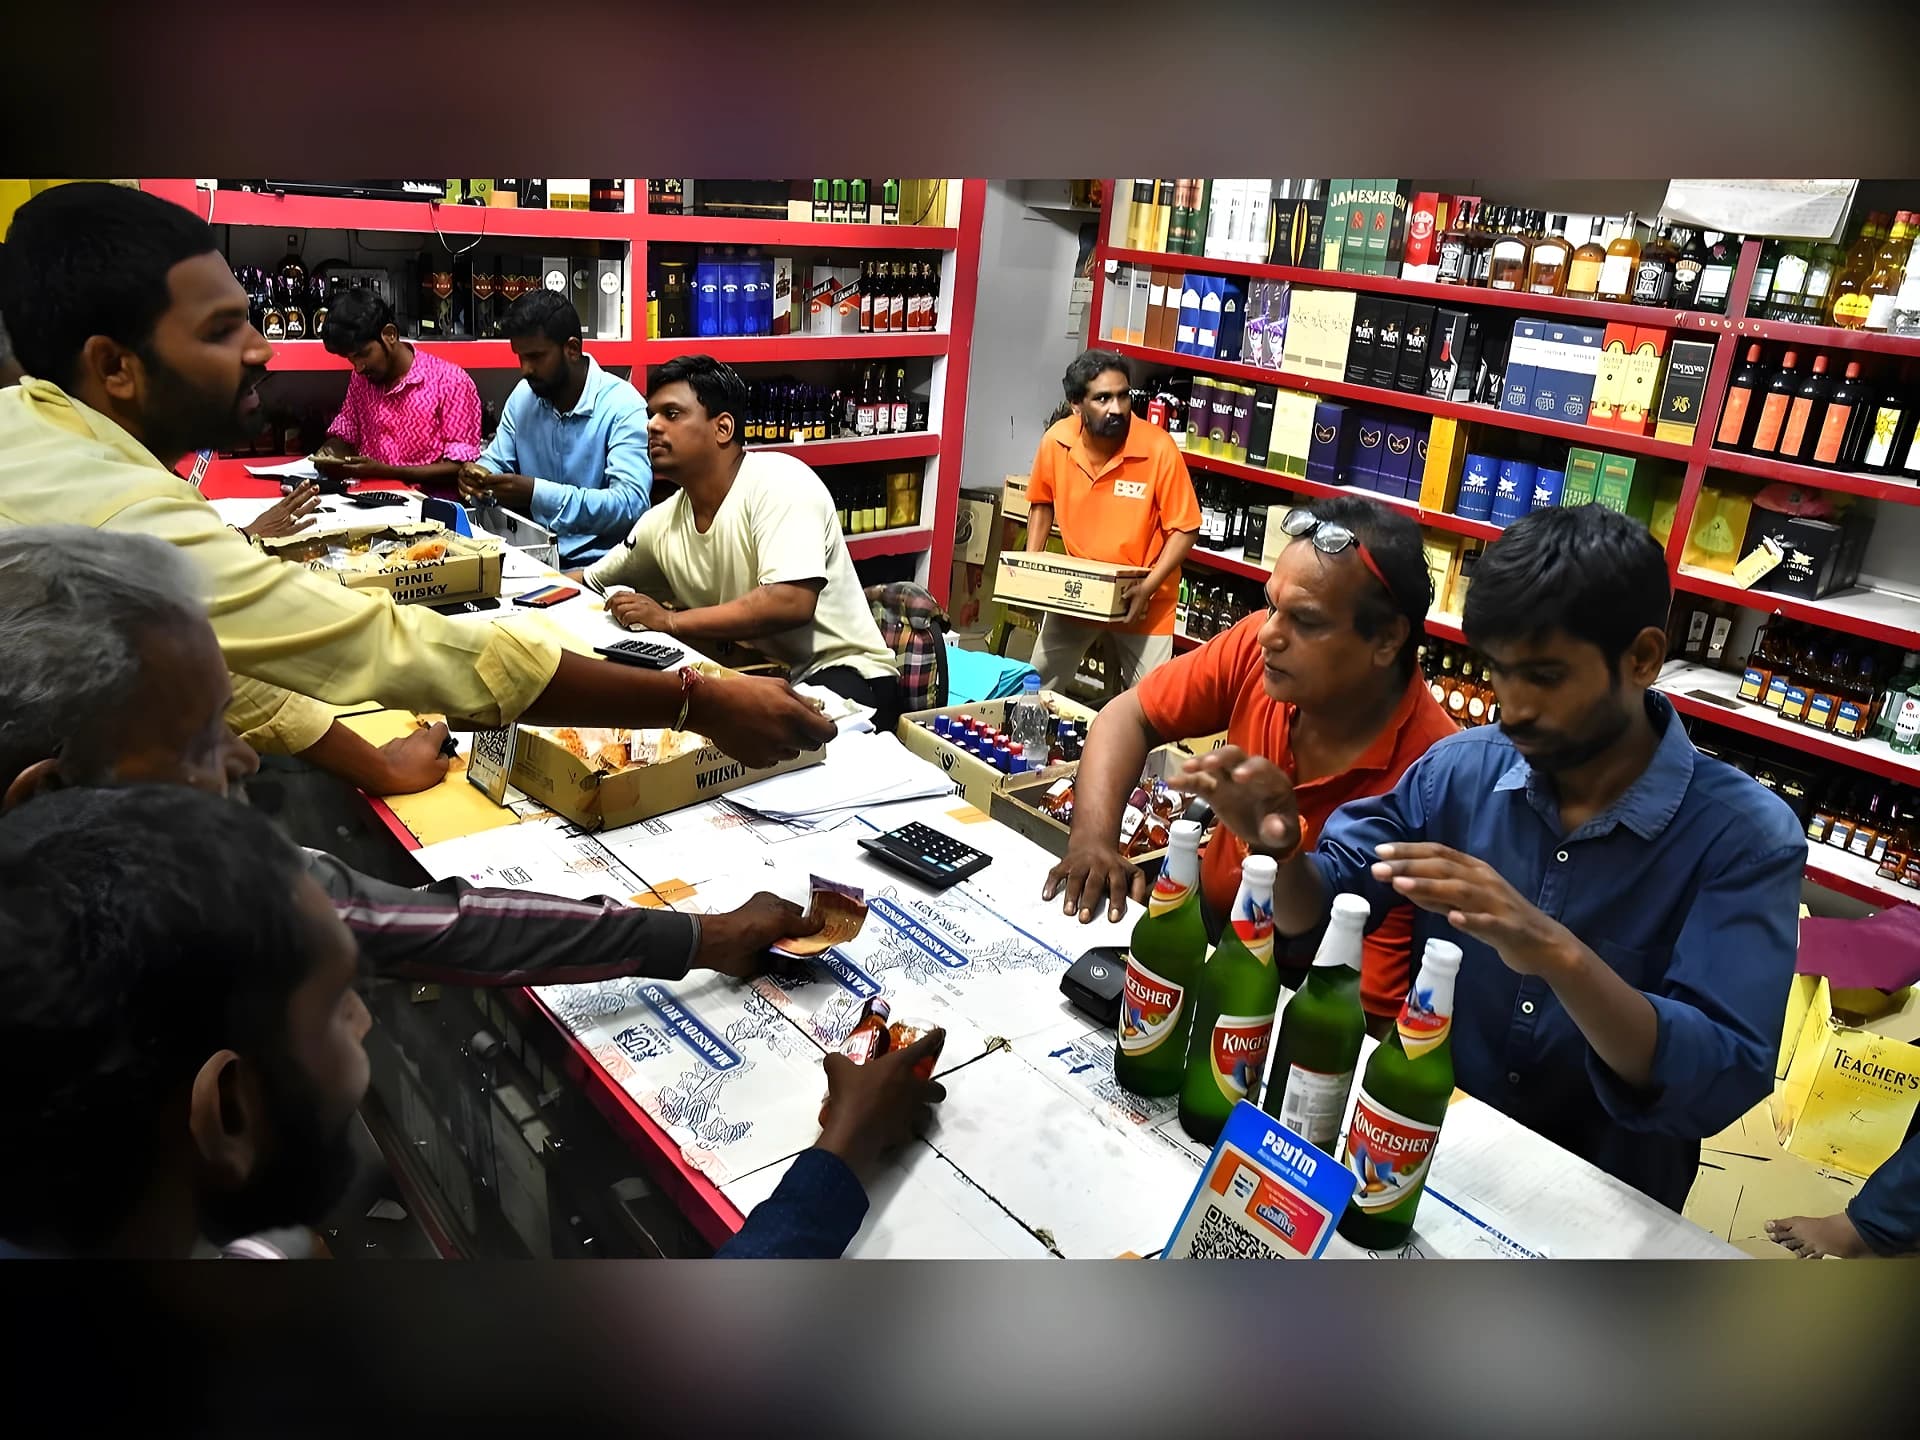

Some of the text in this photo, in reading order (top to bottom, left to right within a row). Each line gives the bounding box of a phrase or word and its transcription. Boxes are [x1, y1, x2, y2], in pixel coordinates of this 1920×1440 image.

[395, 572, 434, 587] FINE
[696, 761, 746, 790] WHISKY
[675, 1018, 735, 1067] MANSION
[1833, 1047, 1920, 1090] TEACHER'S
[1353, 1105, 1429, 1153] KINGFISHER
